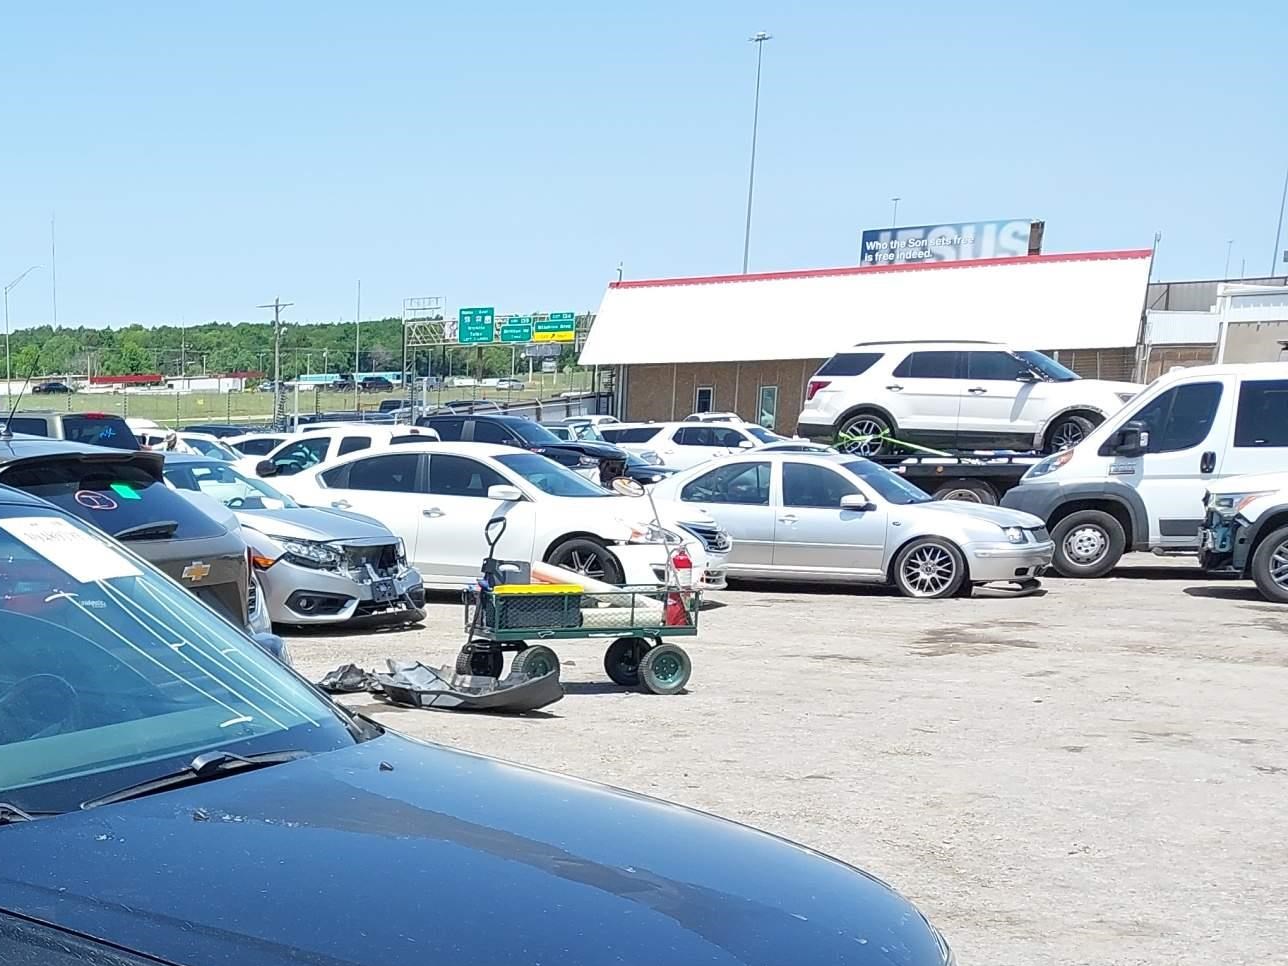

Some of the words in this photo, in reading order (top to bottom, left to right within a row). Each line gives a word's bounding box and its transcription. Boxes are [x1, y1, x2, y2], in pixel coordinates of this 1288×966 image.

[865, 241, 888, 250] Who
[890, 240, 906, 249] the
[908, 238, 928, 248] Son
[929, 237, 952, 246] sets
[953, 235, 975, 245] free
[864, 252, 874, 262] is
[874, 251, 895, 261] free
[895, 249, 933, 260] indeed.
